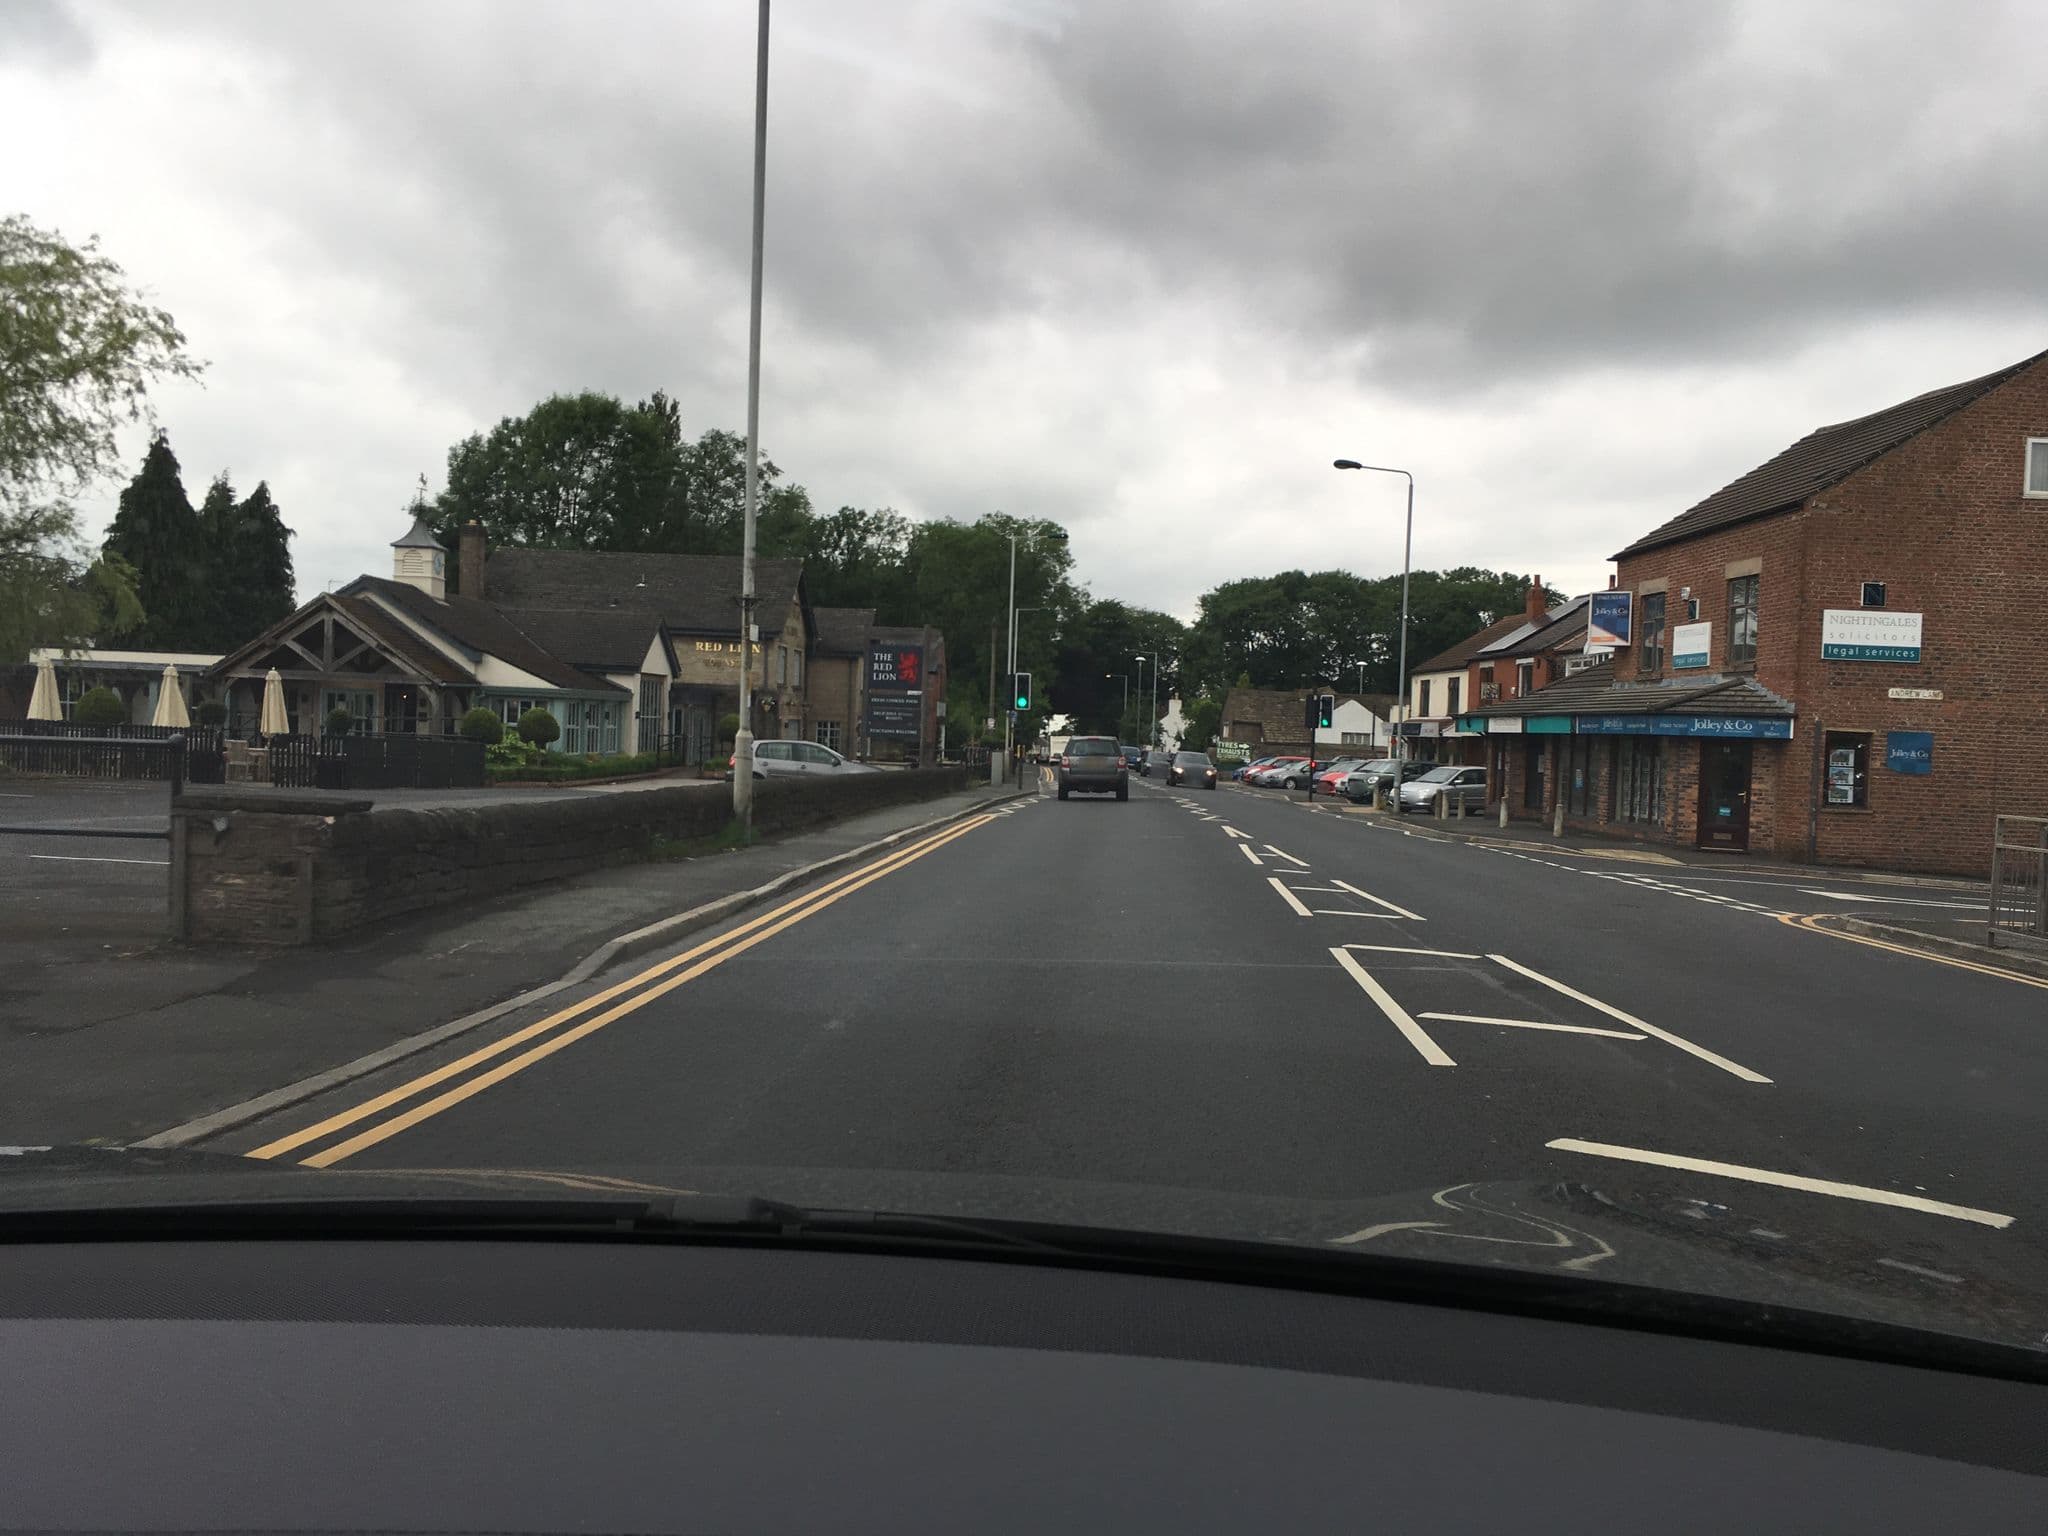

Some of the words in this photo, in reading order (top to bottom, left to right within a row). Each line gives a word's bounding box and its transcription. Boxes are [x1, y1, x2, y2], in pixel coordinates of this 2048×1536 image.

[1829, 614, 1918, 627] NIGHTINGALES
[1829, 631, 1916, 642] solicitors
[695, 641, 722, 652] RED
[729, 643, 761, 654] LIN
[1828, 645, 1859, 657] legal
[1865, 648, 1915, 658] services
[874, 652, 893, 661] THE
[873, 662, 893, 671] RED
[873, 672, 897, 681] LION
[1690, 718, 1722, 732] Jolley
[1723, 719, 1734, 730] &
[1735, 719, 1753, 731] Co
[1917, 750, 1929, 759] Co
